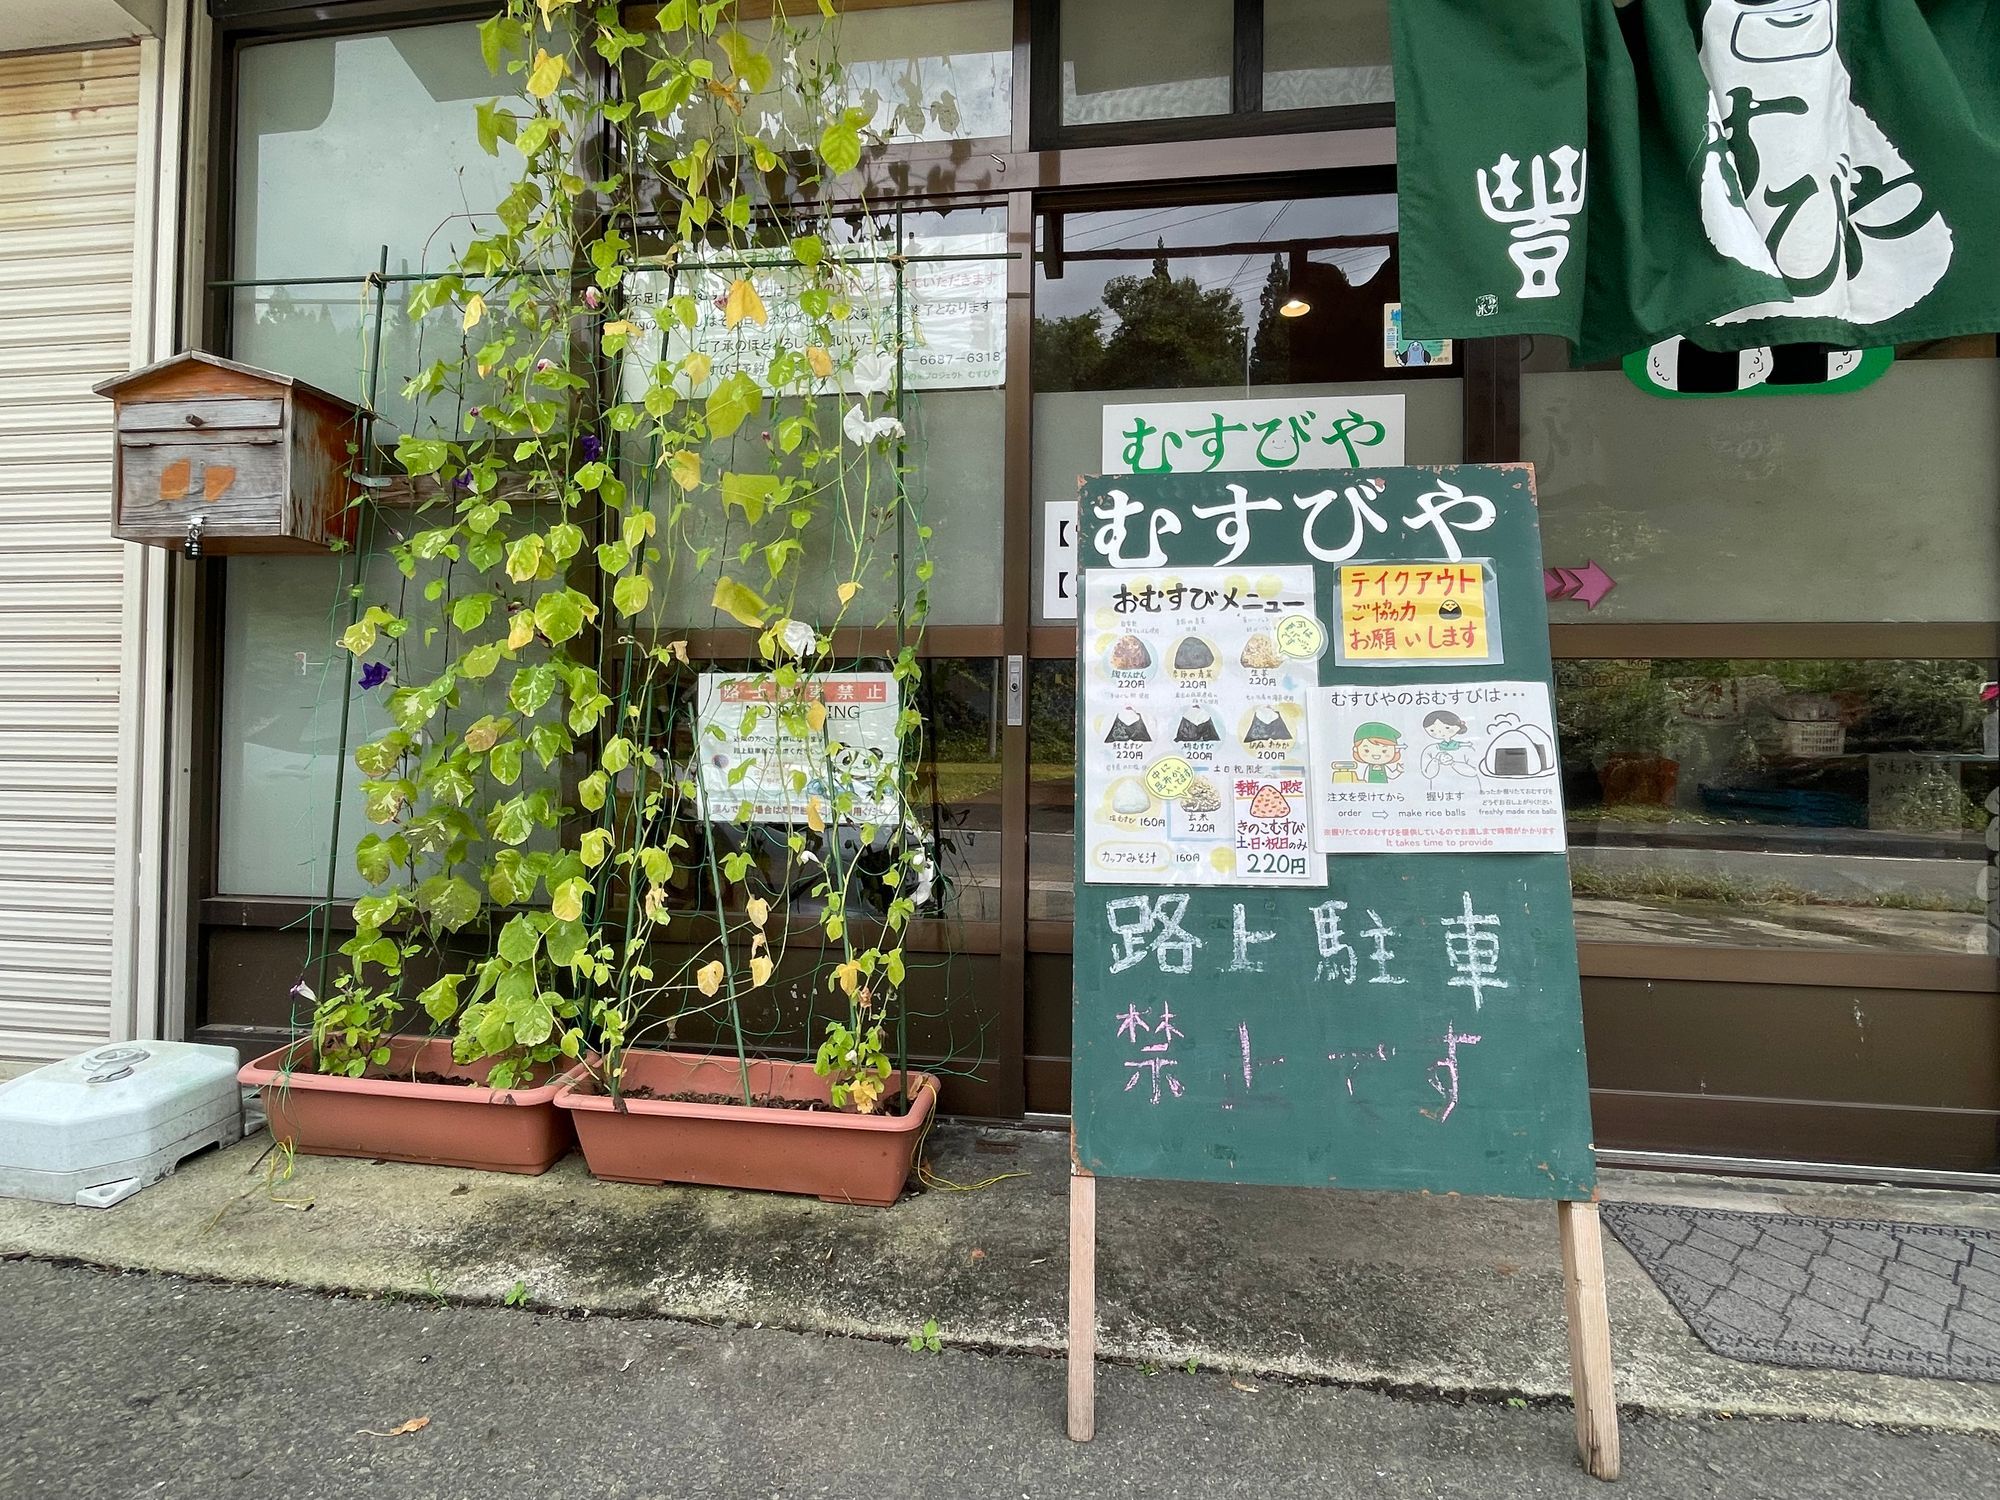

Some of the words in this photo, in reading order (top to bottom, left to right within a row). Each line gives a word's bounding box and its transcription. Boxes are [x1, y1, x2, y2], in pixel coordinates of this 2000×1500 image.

[1122, 409, 1387, 474] むすびや
[1093, 478, 1497, 568] むすびや
[1351, 568, 1476, 597] テイクアウト
[1113, 583, 1305, 614] おむすびメニュー
[1351, 600, 1416, 622] ご協力
[1349, 621, 1478, 651] お願いします
[1118, 680, 1145, 689] 220円
[1180, 680, 1207, 689] 220円
[1248, 677, 1276, 688] 220円
[1116, 751, 1143, 760] 220円
[1186, 751, 1213, 761] 200円
[1257, 751, 1286, 760] 200円
[1234, 779, 1260, 797] 季節
[1280, 779, 1304, 794] 限定
[1327, 791, 1405, 802] 注文を受けてから
[1426, 791, 1464, 802] 握ります
[1338, 809, 1362, 817] order
[1398, 809, 1422, 817] make
[1425, 809, 1442, 817] rice
[1445, 808, 1466, 817] balls
[1478, 808, 1503, 816] freshly
[1140, 817, 1166, 828] 160円
[1188, 823, 1215, 833] 220円
[1237, 818, 1306, 836] きのこむすび
[1386, 839, 1393, 847] It
[1395, 839, 1420, 847] takes
[1424, 839, 1443, 847] time
[1446, 839, 1456, 847] to
[1459, 838, 1493, 848] provide
[1102, 851, 1157, 864] カップみそ汁
[1176, 853, 1200, 863] 160円
[1247, 853, 1306, 875] 220円
[1106, 892, 1508, 1012] 路上駐車
